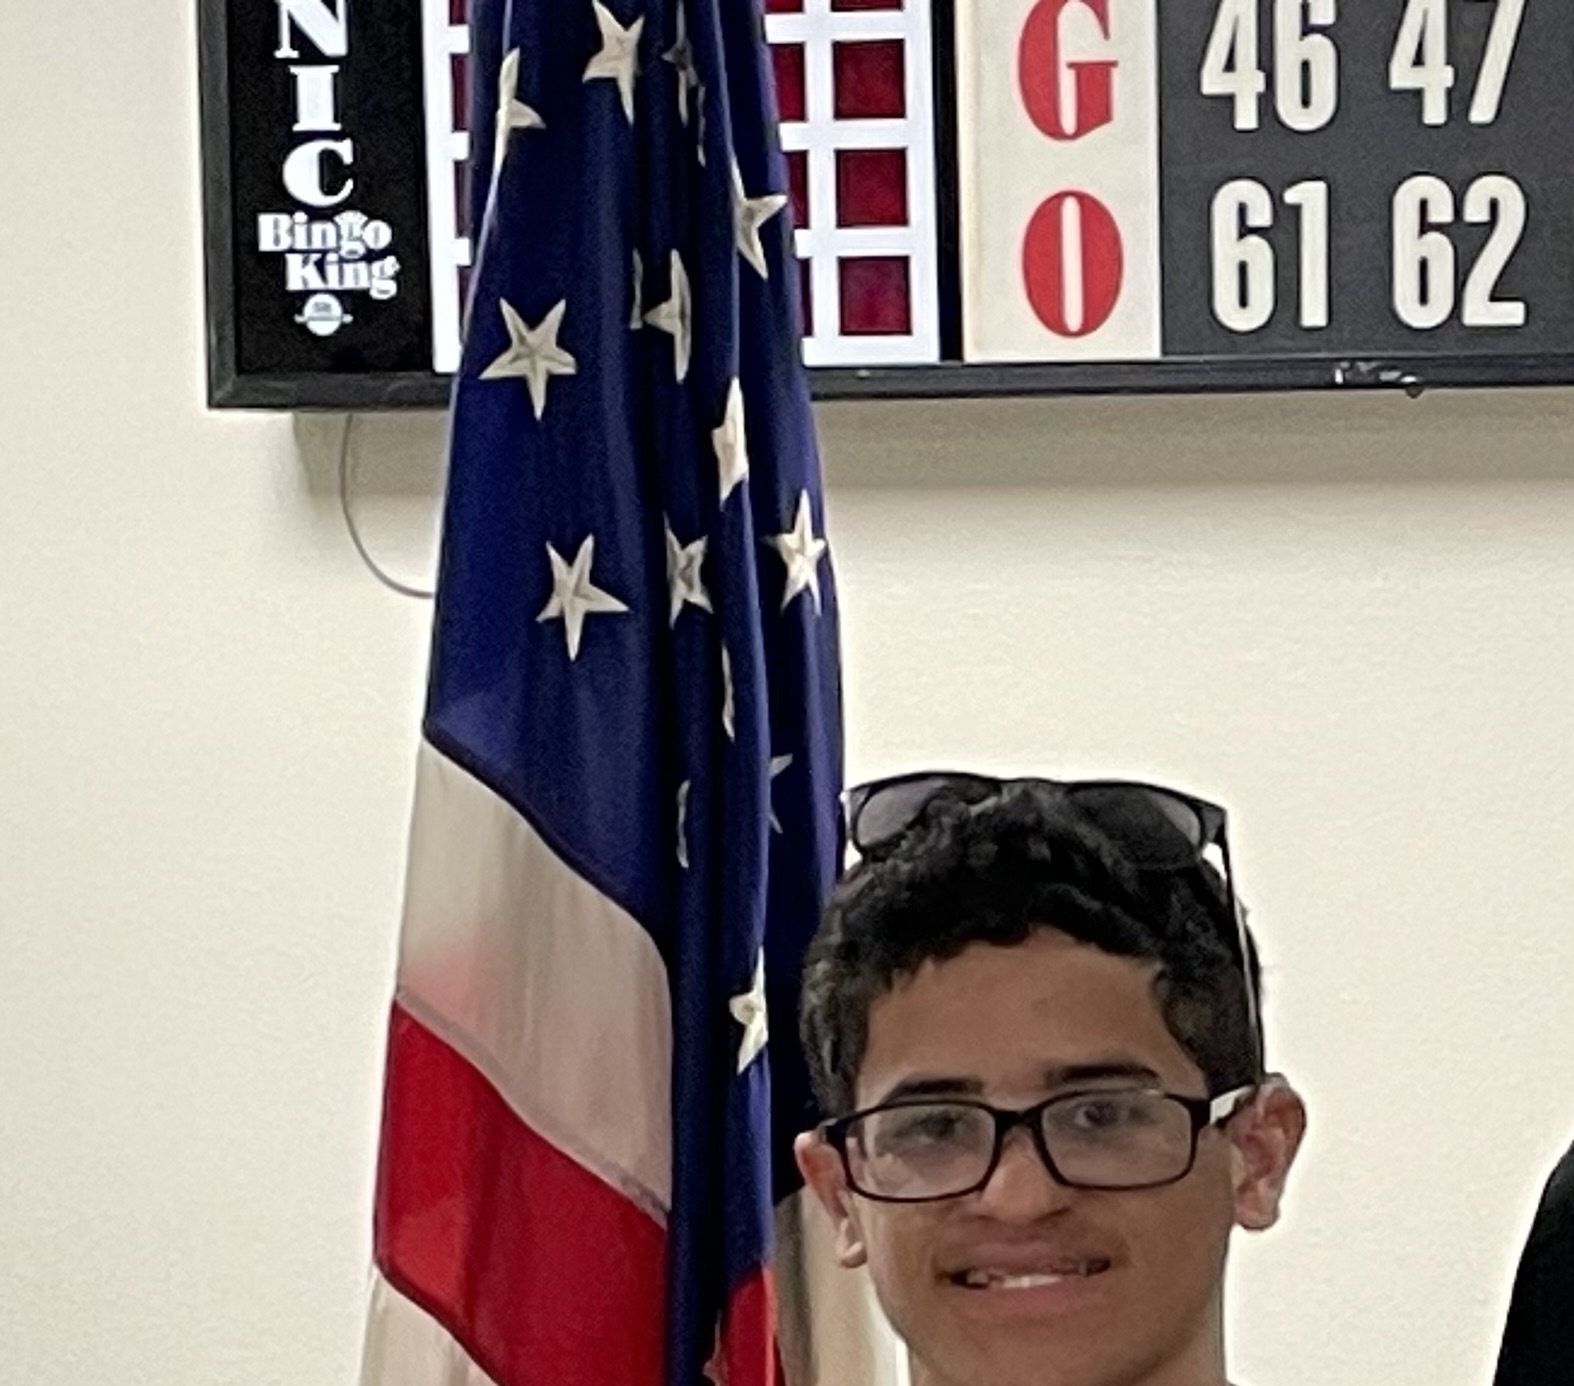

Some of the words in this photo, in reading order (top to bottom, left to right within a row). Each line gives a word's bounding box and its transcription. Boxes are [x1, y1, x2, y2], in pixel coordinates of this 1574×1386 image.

[1016, 0, 1119, 140] G
[1201, 0, 1337, 131] 46
[1389, 0, 1525, 125] 47
[258, 210, 392, 260] Bingo
[285, 252, 401, 300] King
[1020, 188, 1123, 337] O
[1211, 179, 1329, 332] 61
[1393, 175, 1526, 329] 62
